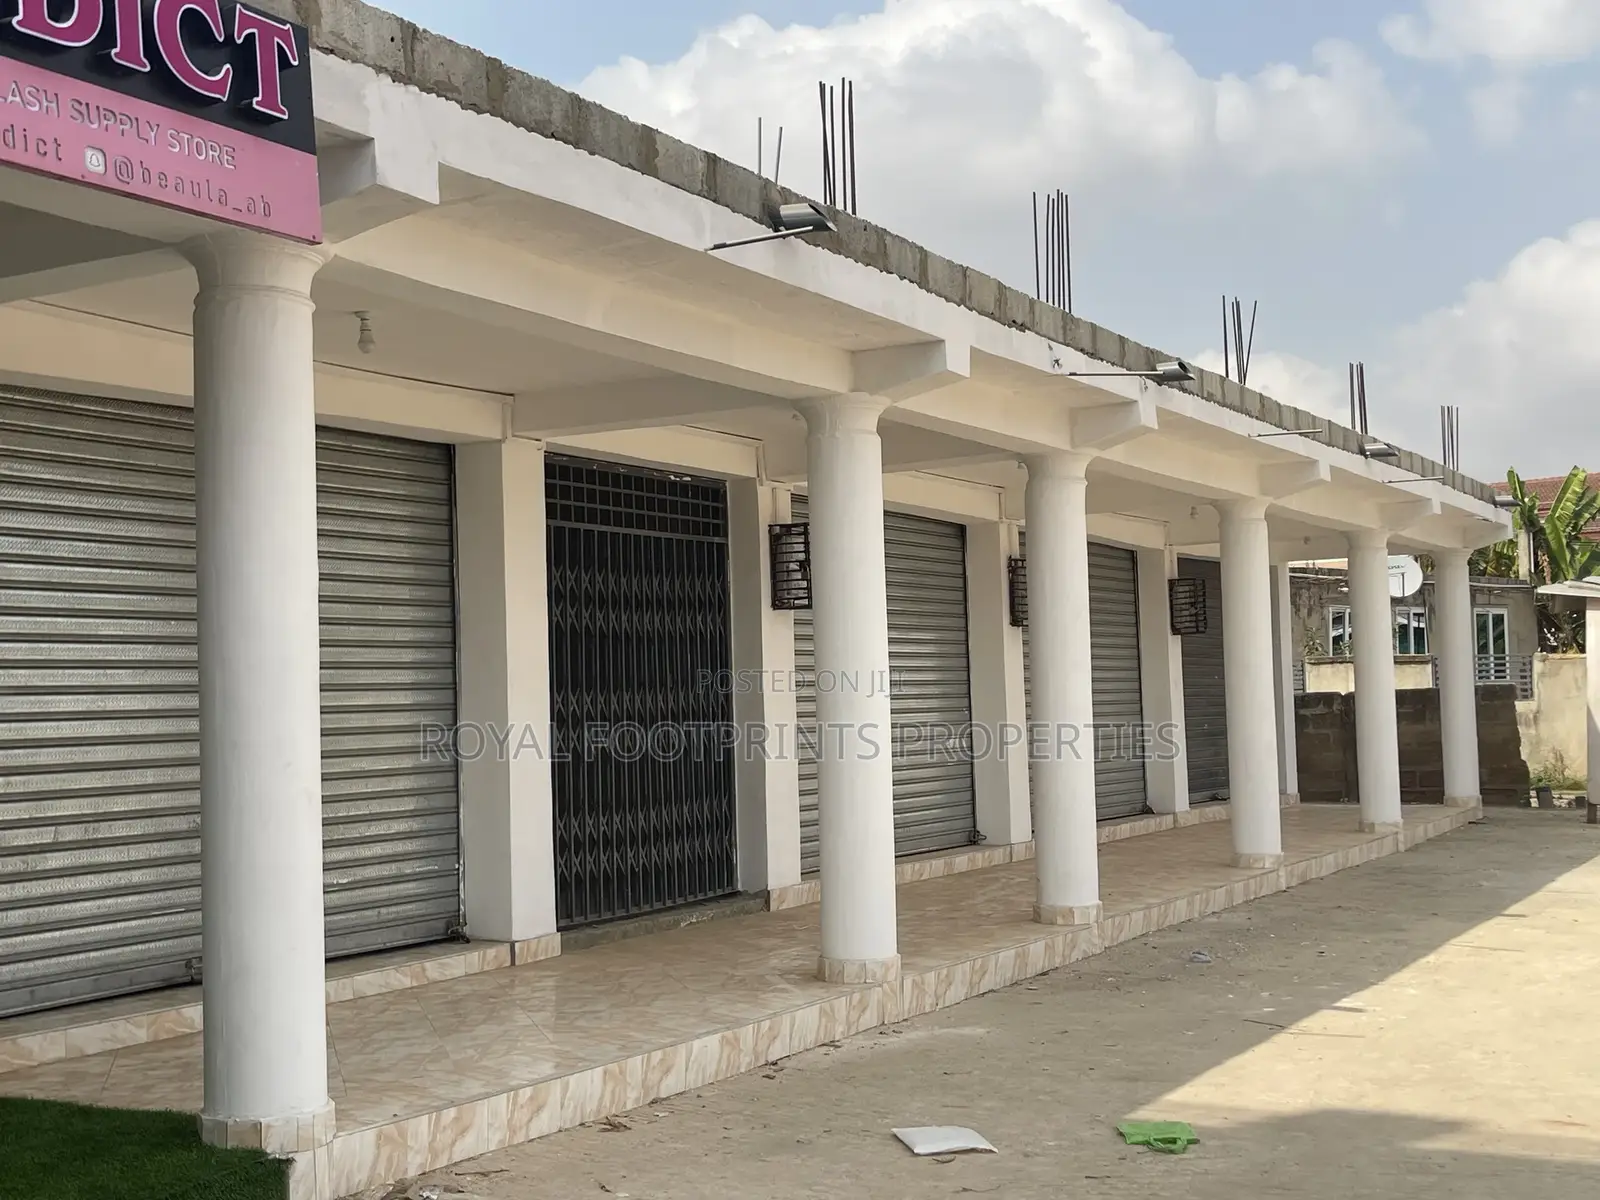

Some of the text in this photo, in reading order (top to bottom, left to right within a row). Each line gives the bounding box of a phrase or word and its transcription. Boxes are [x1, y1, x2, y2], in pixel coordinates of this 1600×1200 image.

[0, 79, 237, 170] ASH SUPPLY STORE
[2, 123, 63, 162] dict
